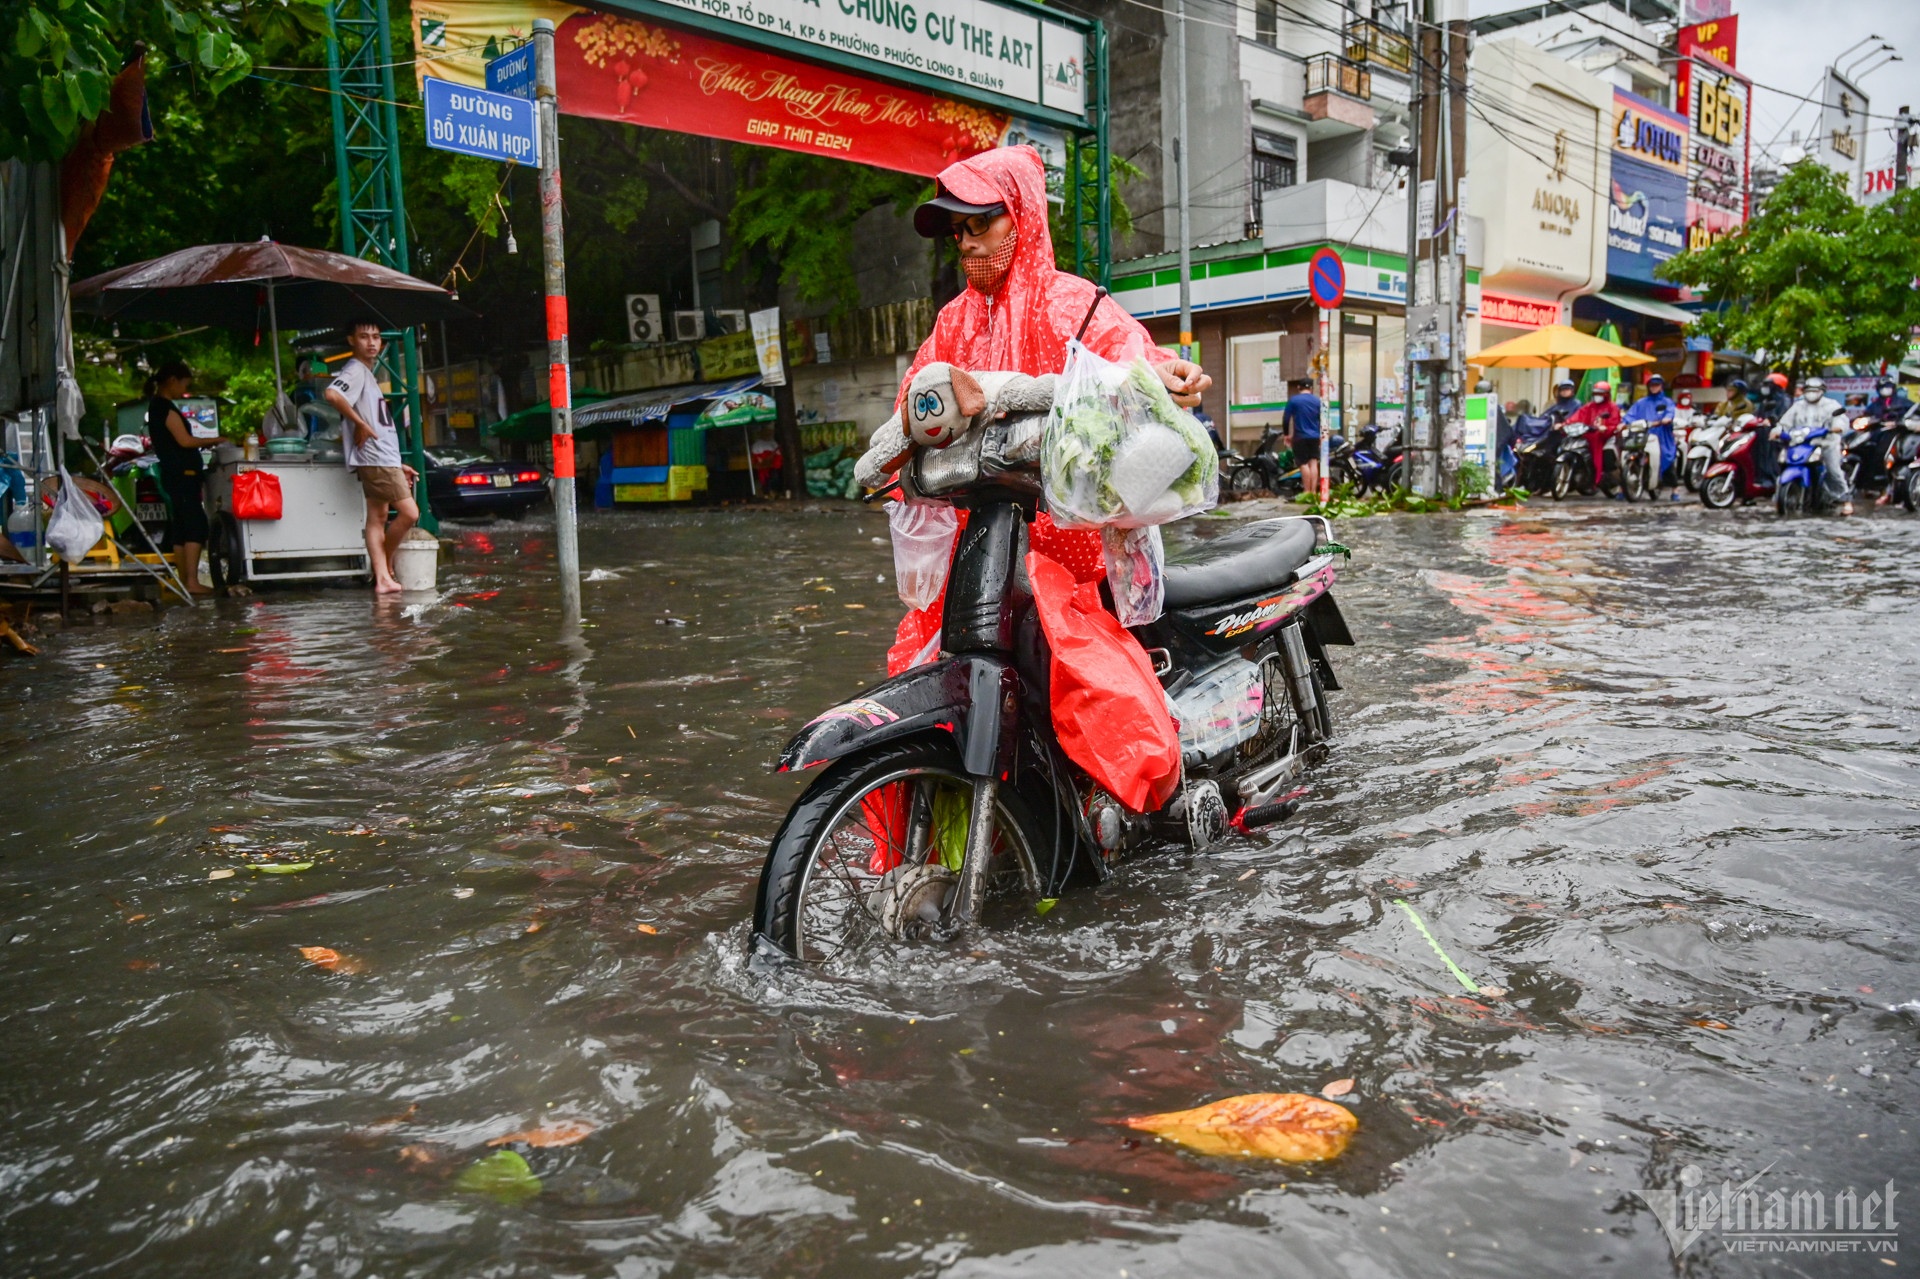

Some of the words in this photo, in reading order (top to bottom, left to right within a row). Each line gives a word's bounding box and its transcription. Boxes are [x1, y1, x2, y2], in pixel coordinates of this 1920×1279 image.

[737, 2, 754, 22] TỔ
[758, 12, 775, 27] DP
[799, 24, 816, 39] KP
[818, 29, 826, 42] 6
[830, 31, 880, 56] PHƯỜNG
[884, 47, 923, 68] PHƯỚC
[926, 59, 955, 76] LONG
[925, 12, 955, 46] CƯ
[961, 22, 993, 59] THE
[999, 35, 1033, 70] ART
[1696, 22, 1719, 43] VP
[449, 93, 513, 121] ĐƯỜNG
[433, 113, 455, 142] ĐỖ
[458, 123, 498, 151] XUÂN
[502, 132, 531, 159] HỢP
[747, 118, 780, 137] GIÁP
[815, 132, 853, 151] 2024
[1635, 117, 1682, 165] JOTUN
[1532, 187, 1580, 225] AMORA
[1214, 602, 1279, 635] Dream
